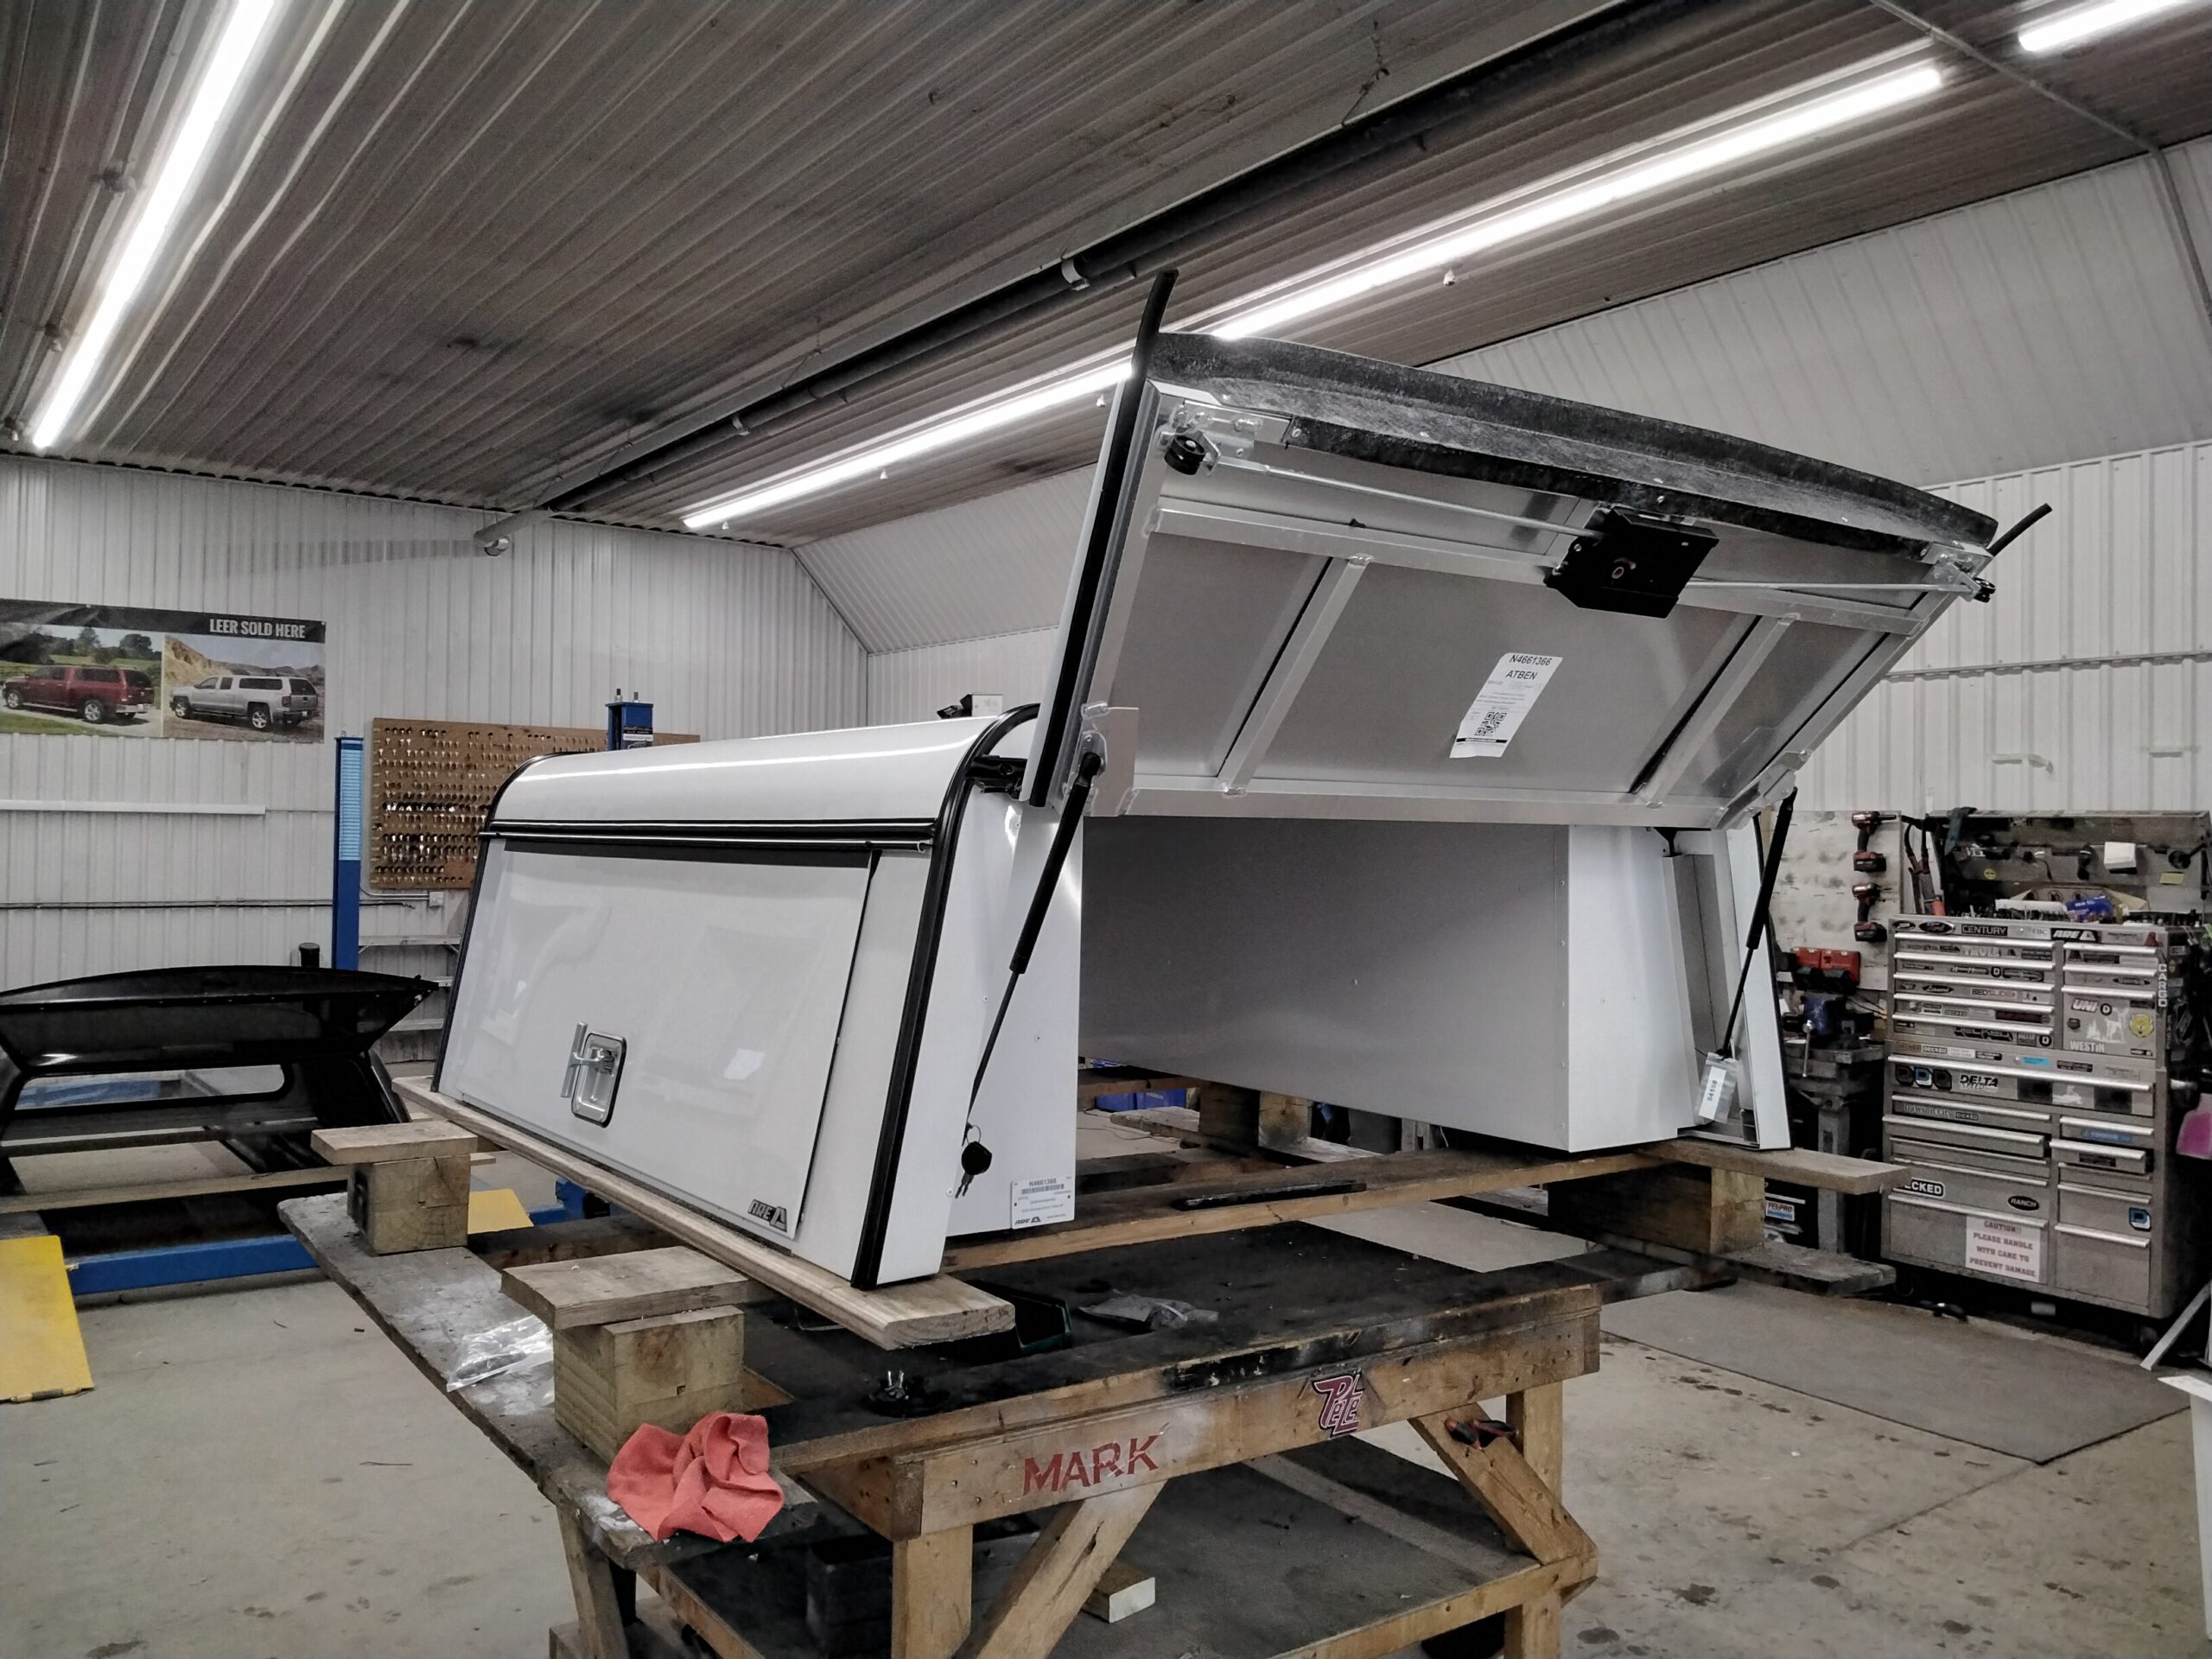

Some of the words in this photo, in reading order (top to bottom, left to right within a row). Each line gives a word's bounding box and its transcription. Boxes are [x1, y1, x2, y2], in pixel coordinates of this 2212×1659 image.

[210, 619, 238, 634] LEER
[240, 621, 272, 636] SOLD
[276, 623, 306, 639] HERE
[1510, 654, 1553, 666] N4661366
[1505, 670, 1538, 680] ATBEN
[1962, 925, 2006, 934] CENTURY
[2158, 963, 2168, 1007] CARGO
[2073, 1000, 2098, 1012] UNI
[1959, 1074, 1999, 1087] DELTA
[2011, 1198, 2037, 1208] RANCH
[1974, 1232, 2001, 1243] PLEASE
[2004, 1238, 2033, 1249] HANDLE
[1976, 1246, 1995, 1255] WITH
[1998, 1250, 2017, 1260] CARE
[1970, 1257, 2003, 1270] PREVENT
[2005, 1265, 2037, 1277] DAMAGE
[1023, 1434, 1160, 1496] MARK
